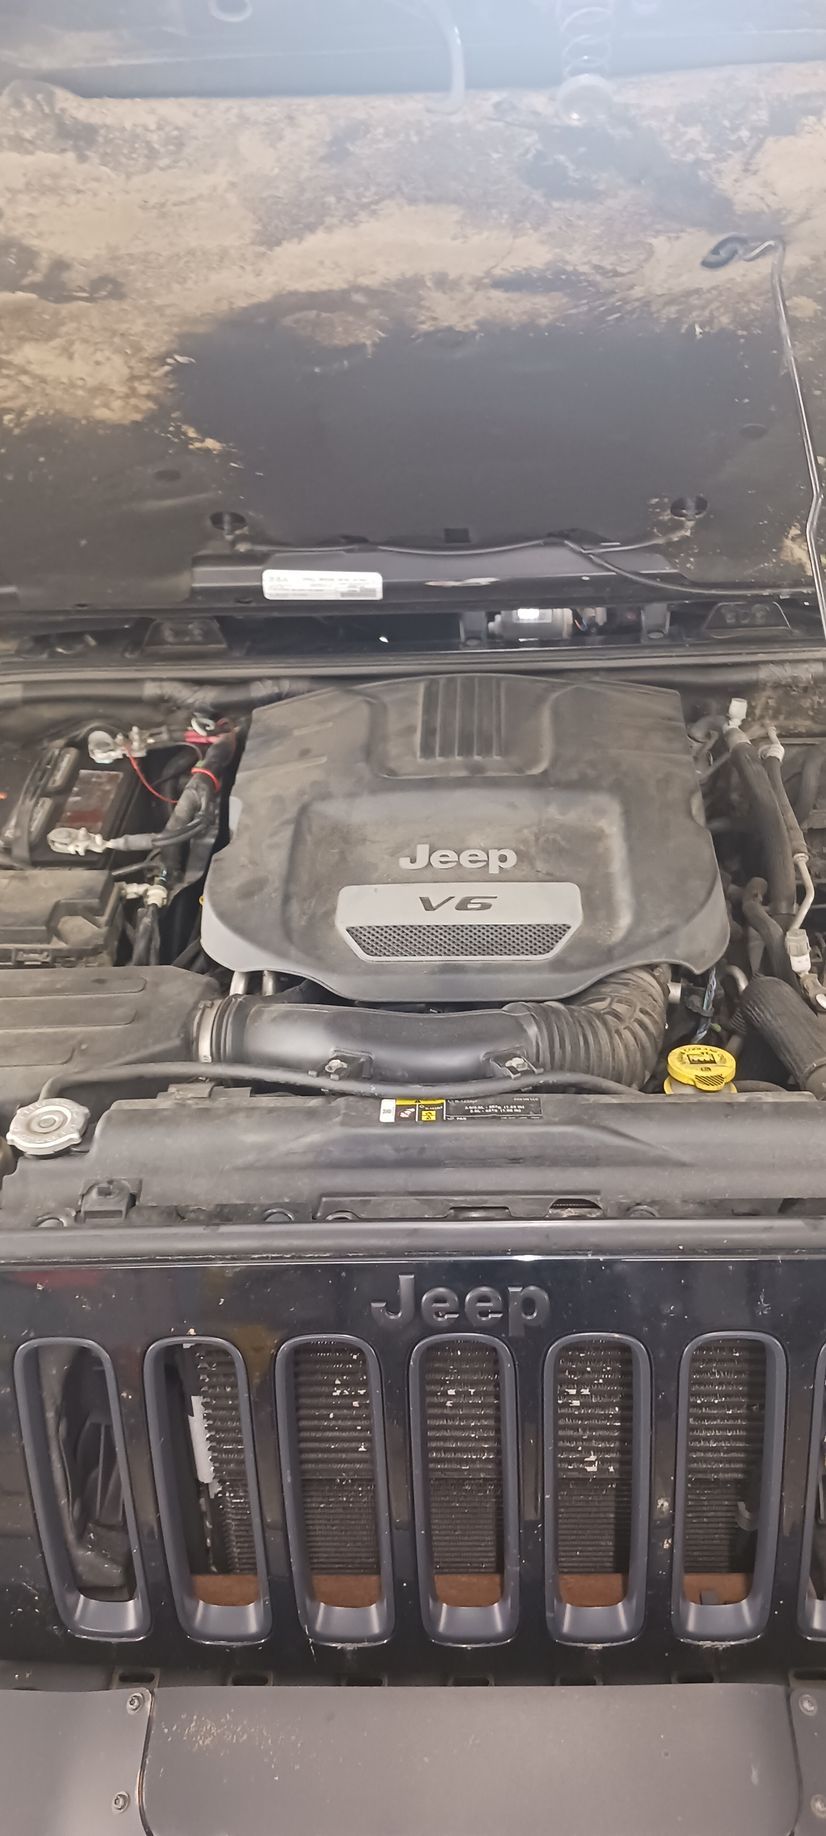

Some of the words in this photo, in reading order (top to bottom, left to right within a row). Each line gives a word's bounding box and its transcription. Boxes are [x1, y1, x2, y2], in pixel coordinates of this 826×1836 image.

[399, 843, 517, 874] Jeep
[419, 895, 498, 912] V6
[371, 1274, 550, 1337] Jeep
